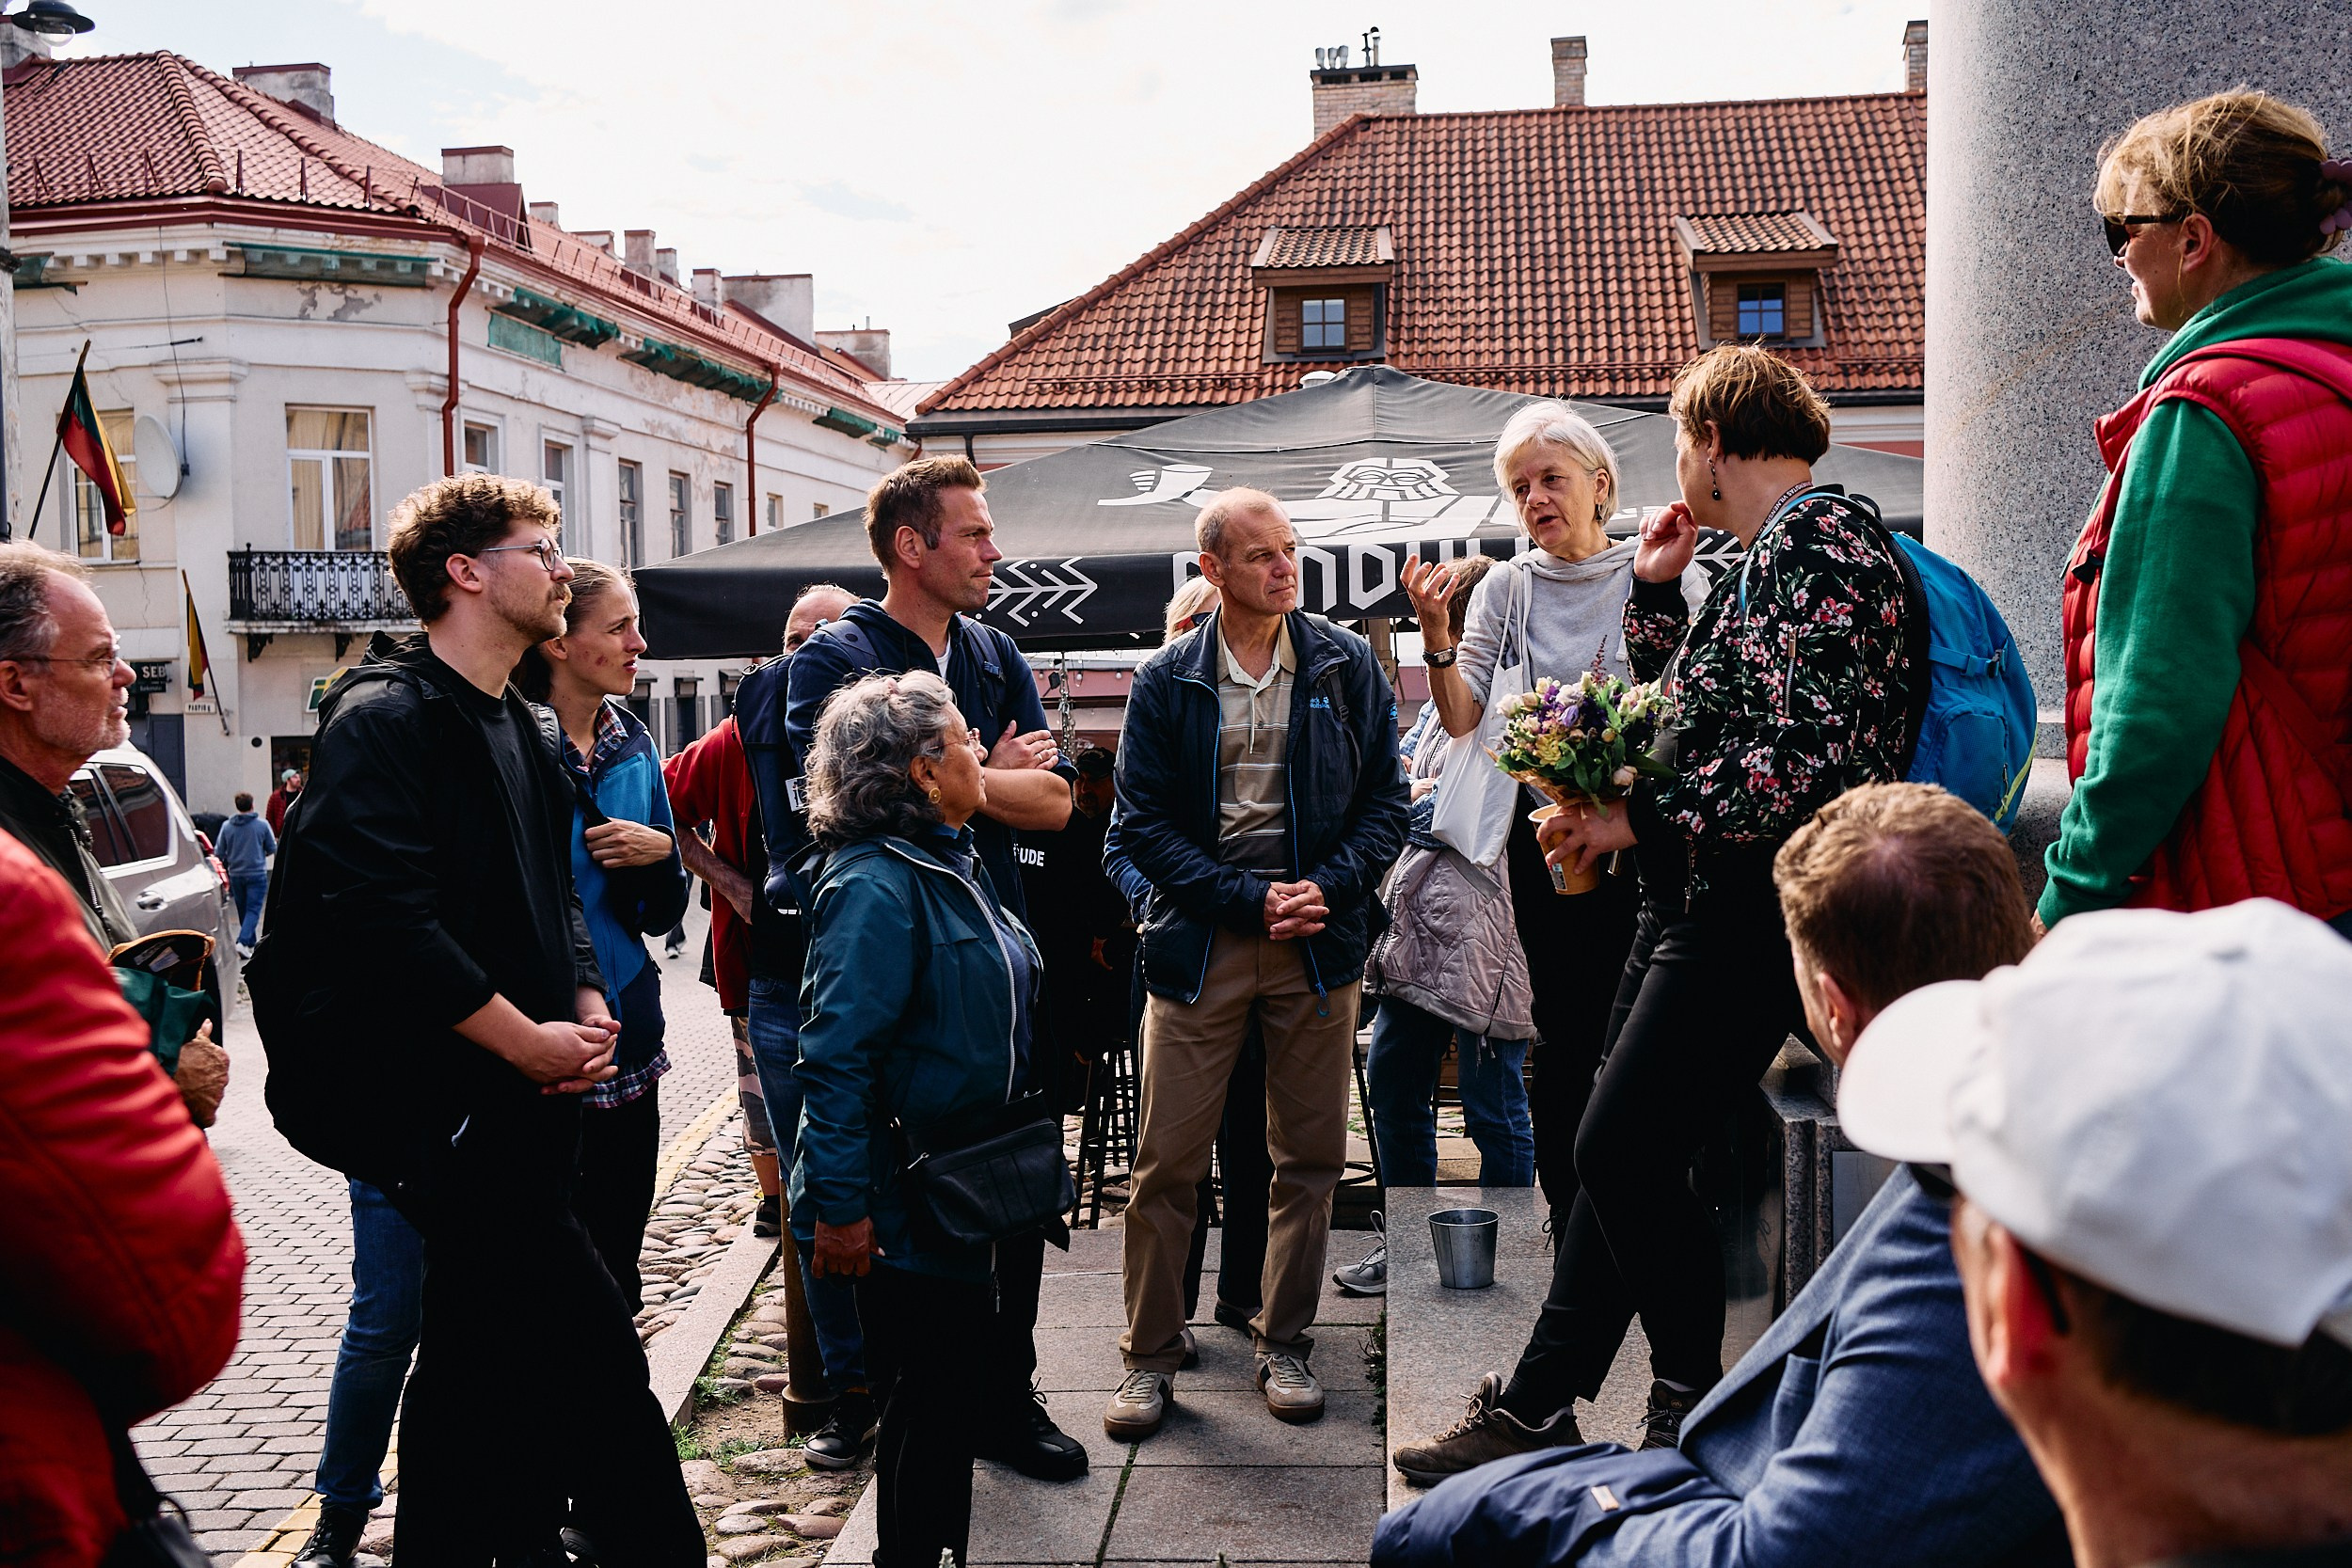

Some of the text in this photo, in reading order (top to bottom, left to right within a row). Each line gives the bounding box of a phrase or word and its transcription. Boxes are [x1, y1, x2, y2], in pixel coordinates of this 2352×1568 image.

[1765, 494, 1788, 524] VILNENSIS
[142, 665, 167, 678] SEB
[1013, 845, 1045, 867] UDE
